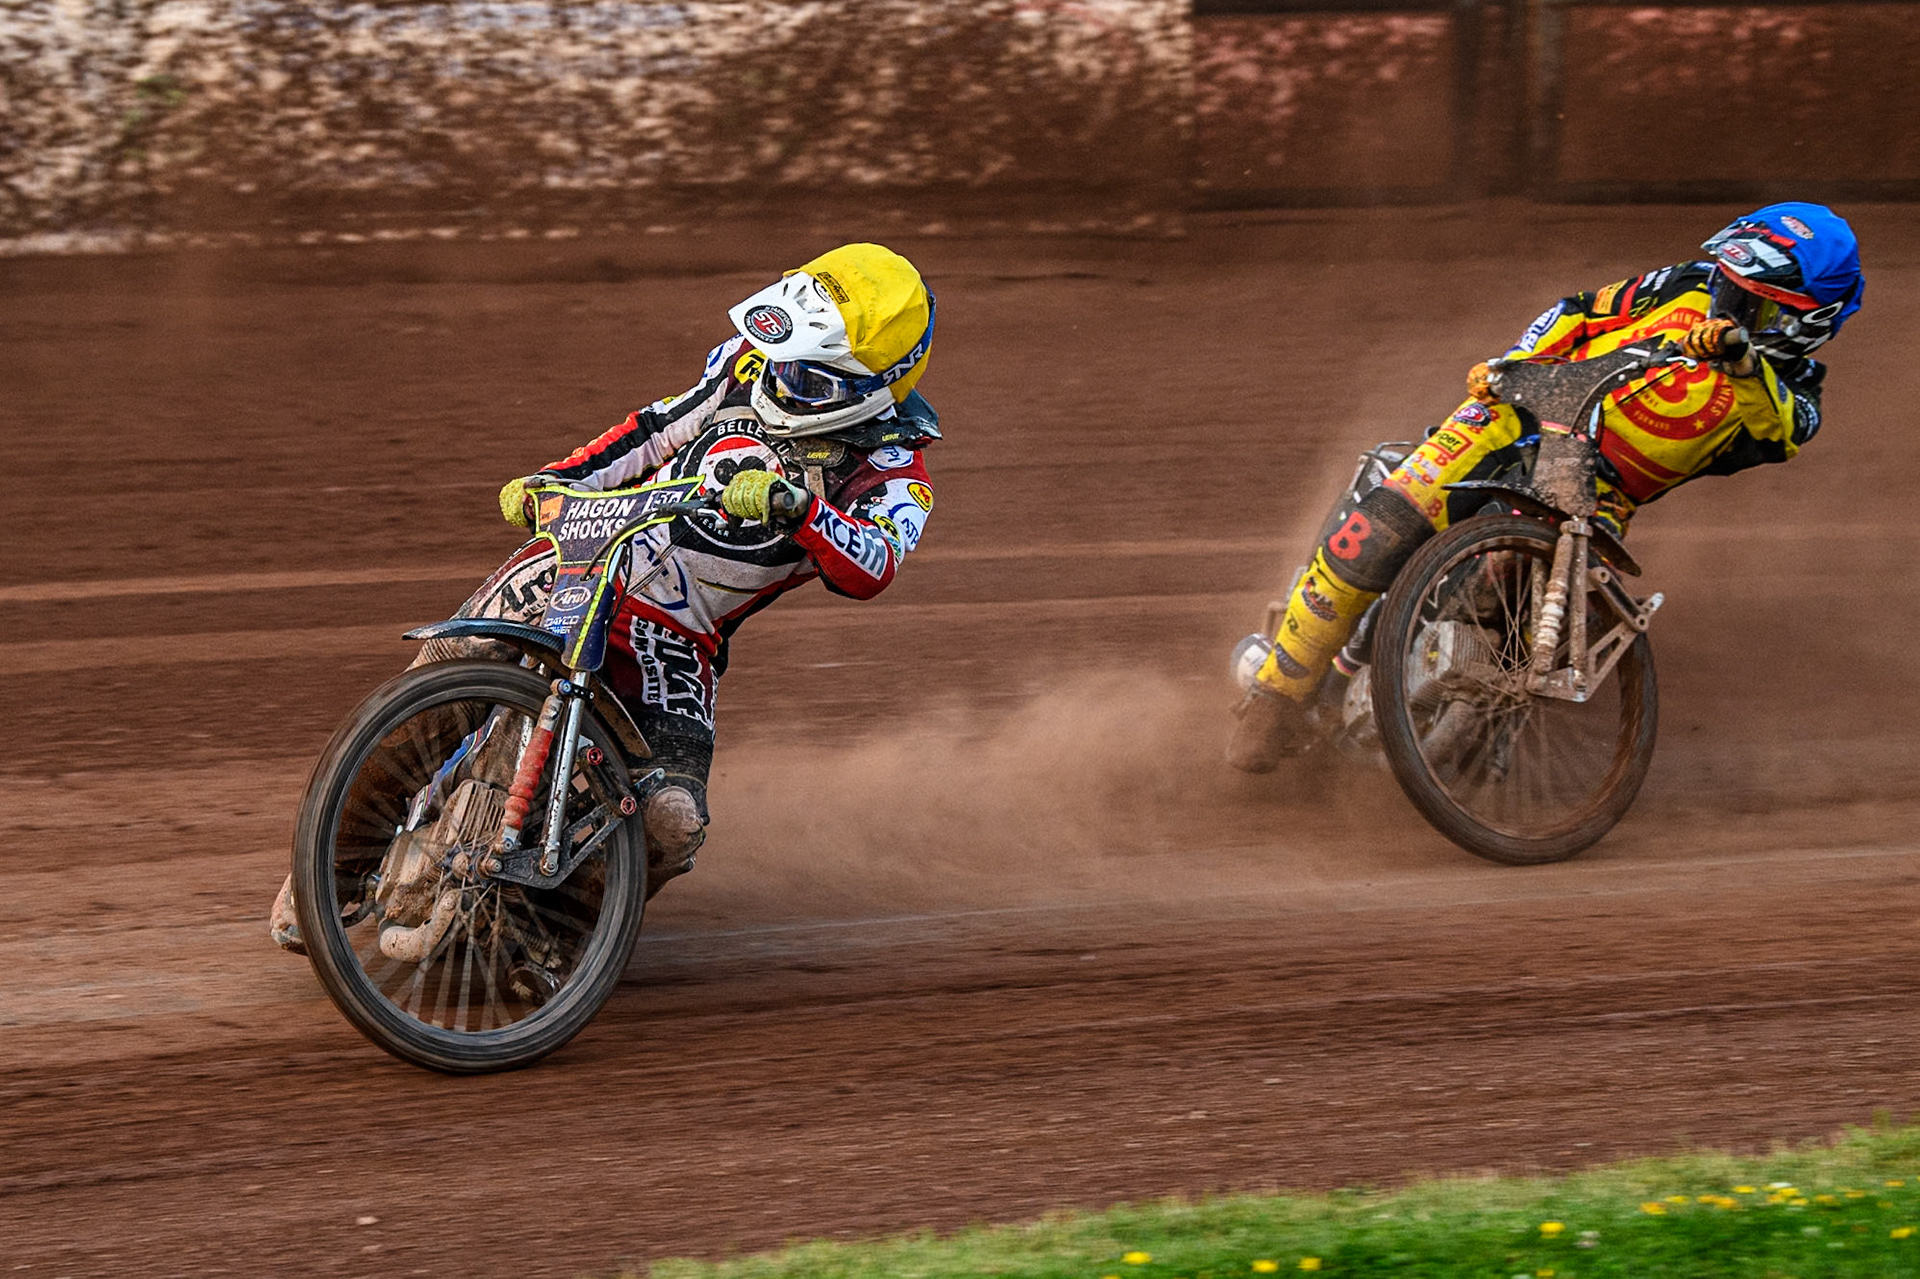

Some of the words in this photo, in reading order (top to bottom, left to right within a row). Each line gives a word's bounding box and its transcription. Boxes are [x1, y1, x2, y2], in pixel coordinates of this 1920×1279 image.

[754, 312, 783, 335] STS
[717, 421, 764, 438] BELLE
[565, 499, 637, 521] HAGON
[558, 518, 627, 541] SHOCKS
[555, 589, 586, 605] Arai
[635, 617, 661, 701] COMOSITE
